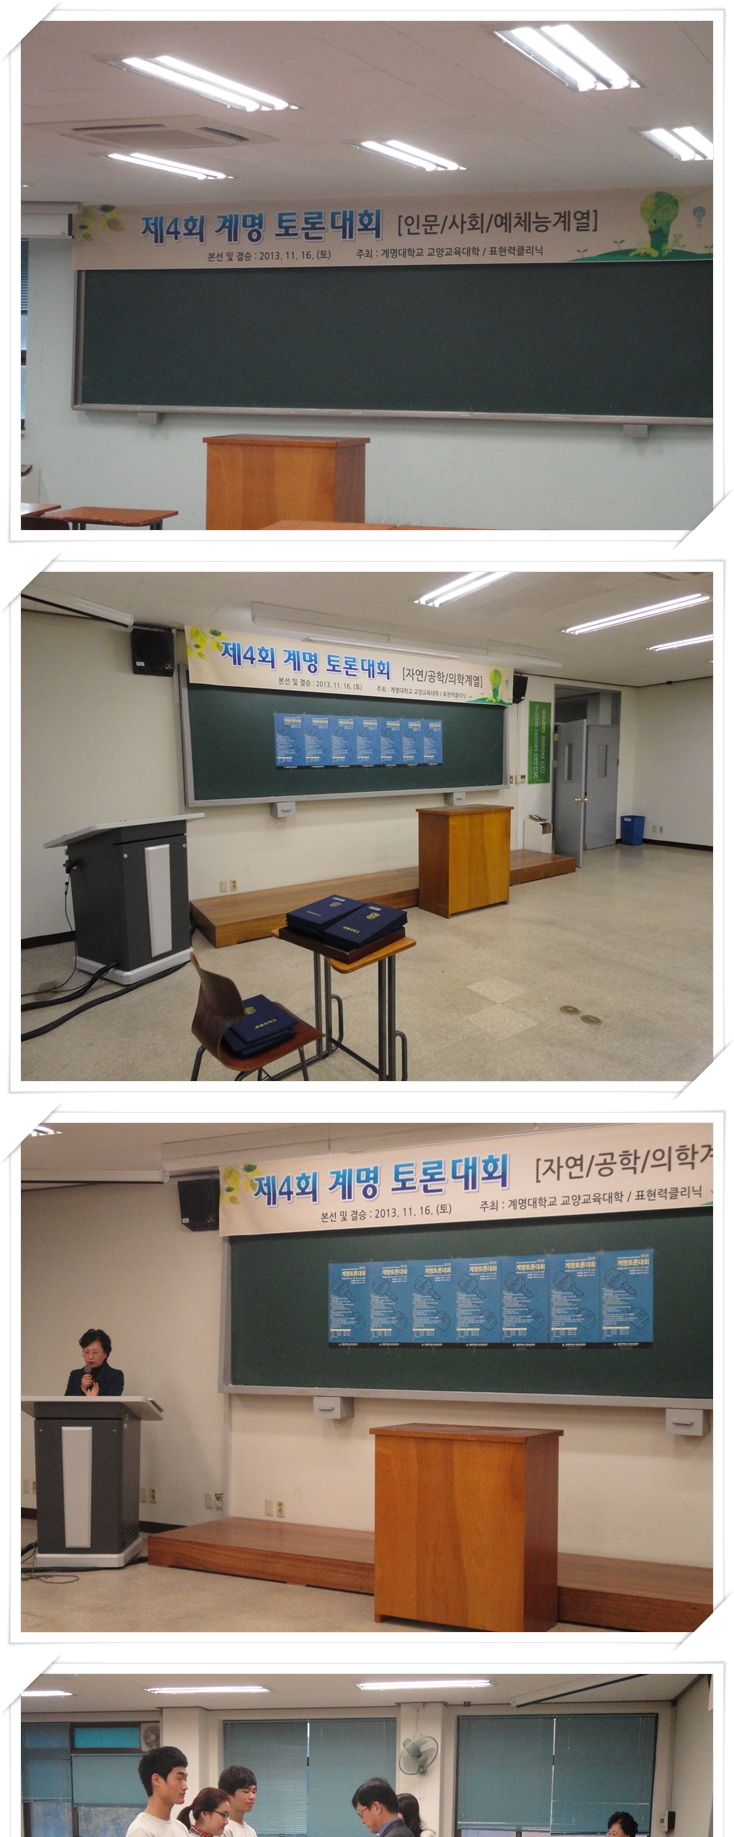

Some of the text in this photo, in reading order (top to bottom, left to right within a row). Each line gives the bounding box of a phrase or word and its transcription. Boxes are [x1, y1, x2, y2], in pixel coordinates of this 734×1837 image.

[141, 209, 598, 244] 제4회 계명 토론대회 [인문/사회/예체능계열]
[208, 252, 224, 261] 본선
[226, 252, 233, 261] 및
[237, 252, 252, 261] 결승
[260, 252, 282, 260] 2013.
[286, 252, 298, 260] 11.
[302, 251, 313, 260] 16.
[316, 250, 331, 260] (토)
[356, 249, 372, 259] 주최
[381, 248, 424, 258] 계명대학교
[427, 247, 480, 257] 교양교육대학
[489, 245, 543, 256] 표현력클리닉
[221, 641, 482, 688] 제4회 계명 토론대회 [자연/공학/의학계열]
[278, 677, 290, 685] 본선
[293, 678, 298, 686] 및
[300, 679, 311, 687] 결승
[254, 1171, 319, 1207] 제4회
[328, 1165, 379, 1200] 계명
[392, 1153, 508, 1192] 토론대회
[480, 1201, 499, 1212] 주최
[508, 1197, 557, 1211] 계명대학교
[560, 1191, 624, 1208] 교양교육대학
[635, 1185, 702, 1201] 표현력클리닉
[321, 1211, 337, 1223] 본선
[340, 1211, 348, 1222] 및
[351, 1210, 367, 1221] 결승
[375, 1208, 399, 1218] 2013.
[403, 1207, 416, 1217] 11.
[420, 1206, 433, 1216] 16.
[436, 1203, 451, 1216] (토)
